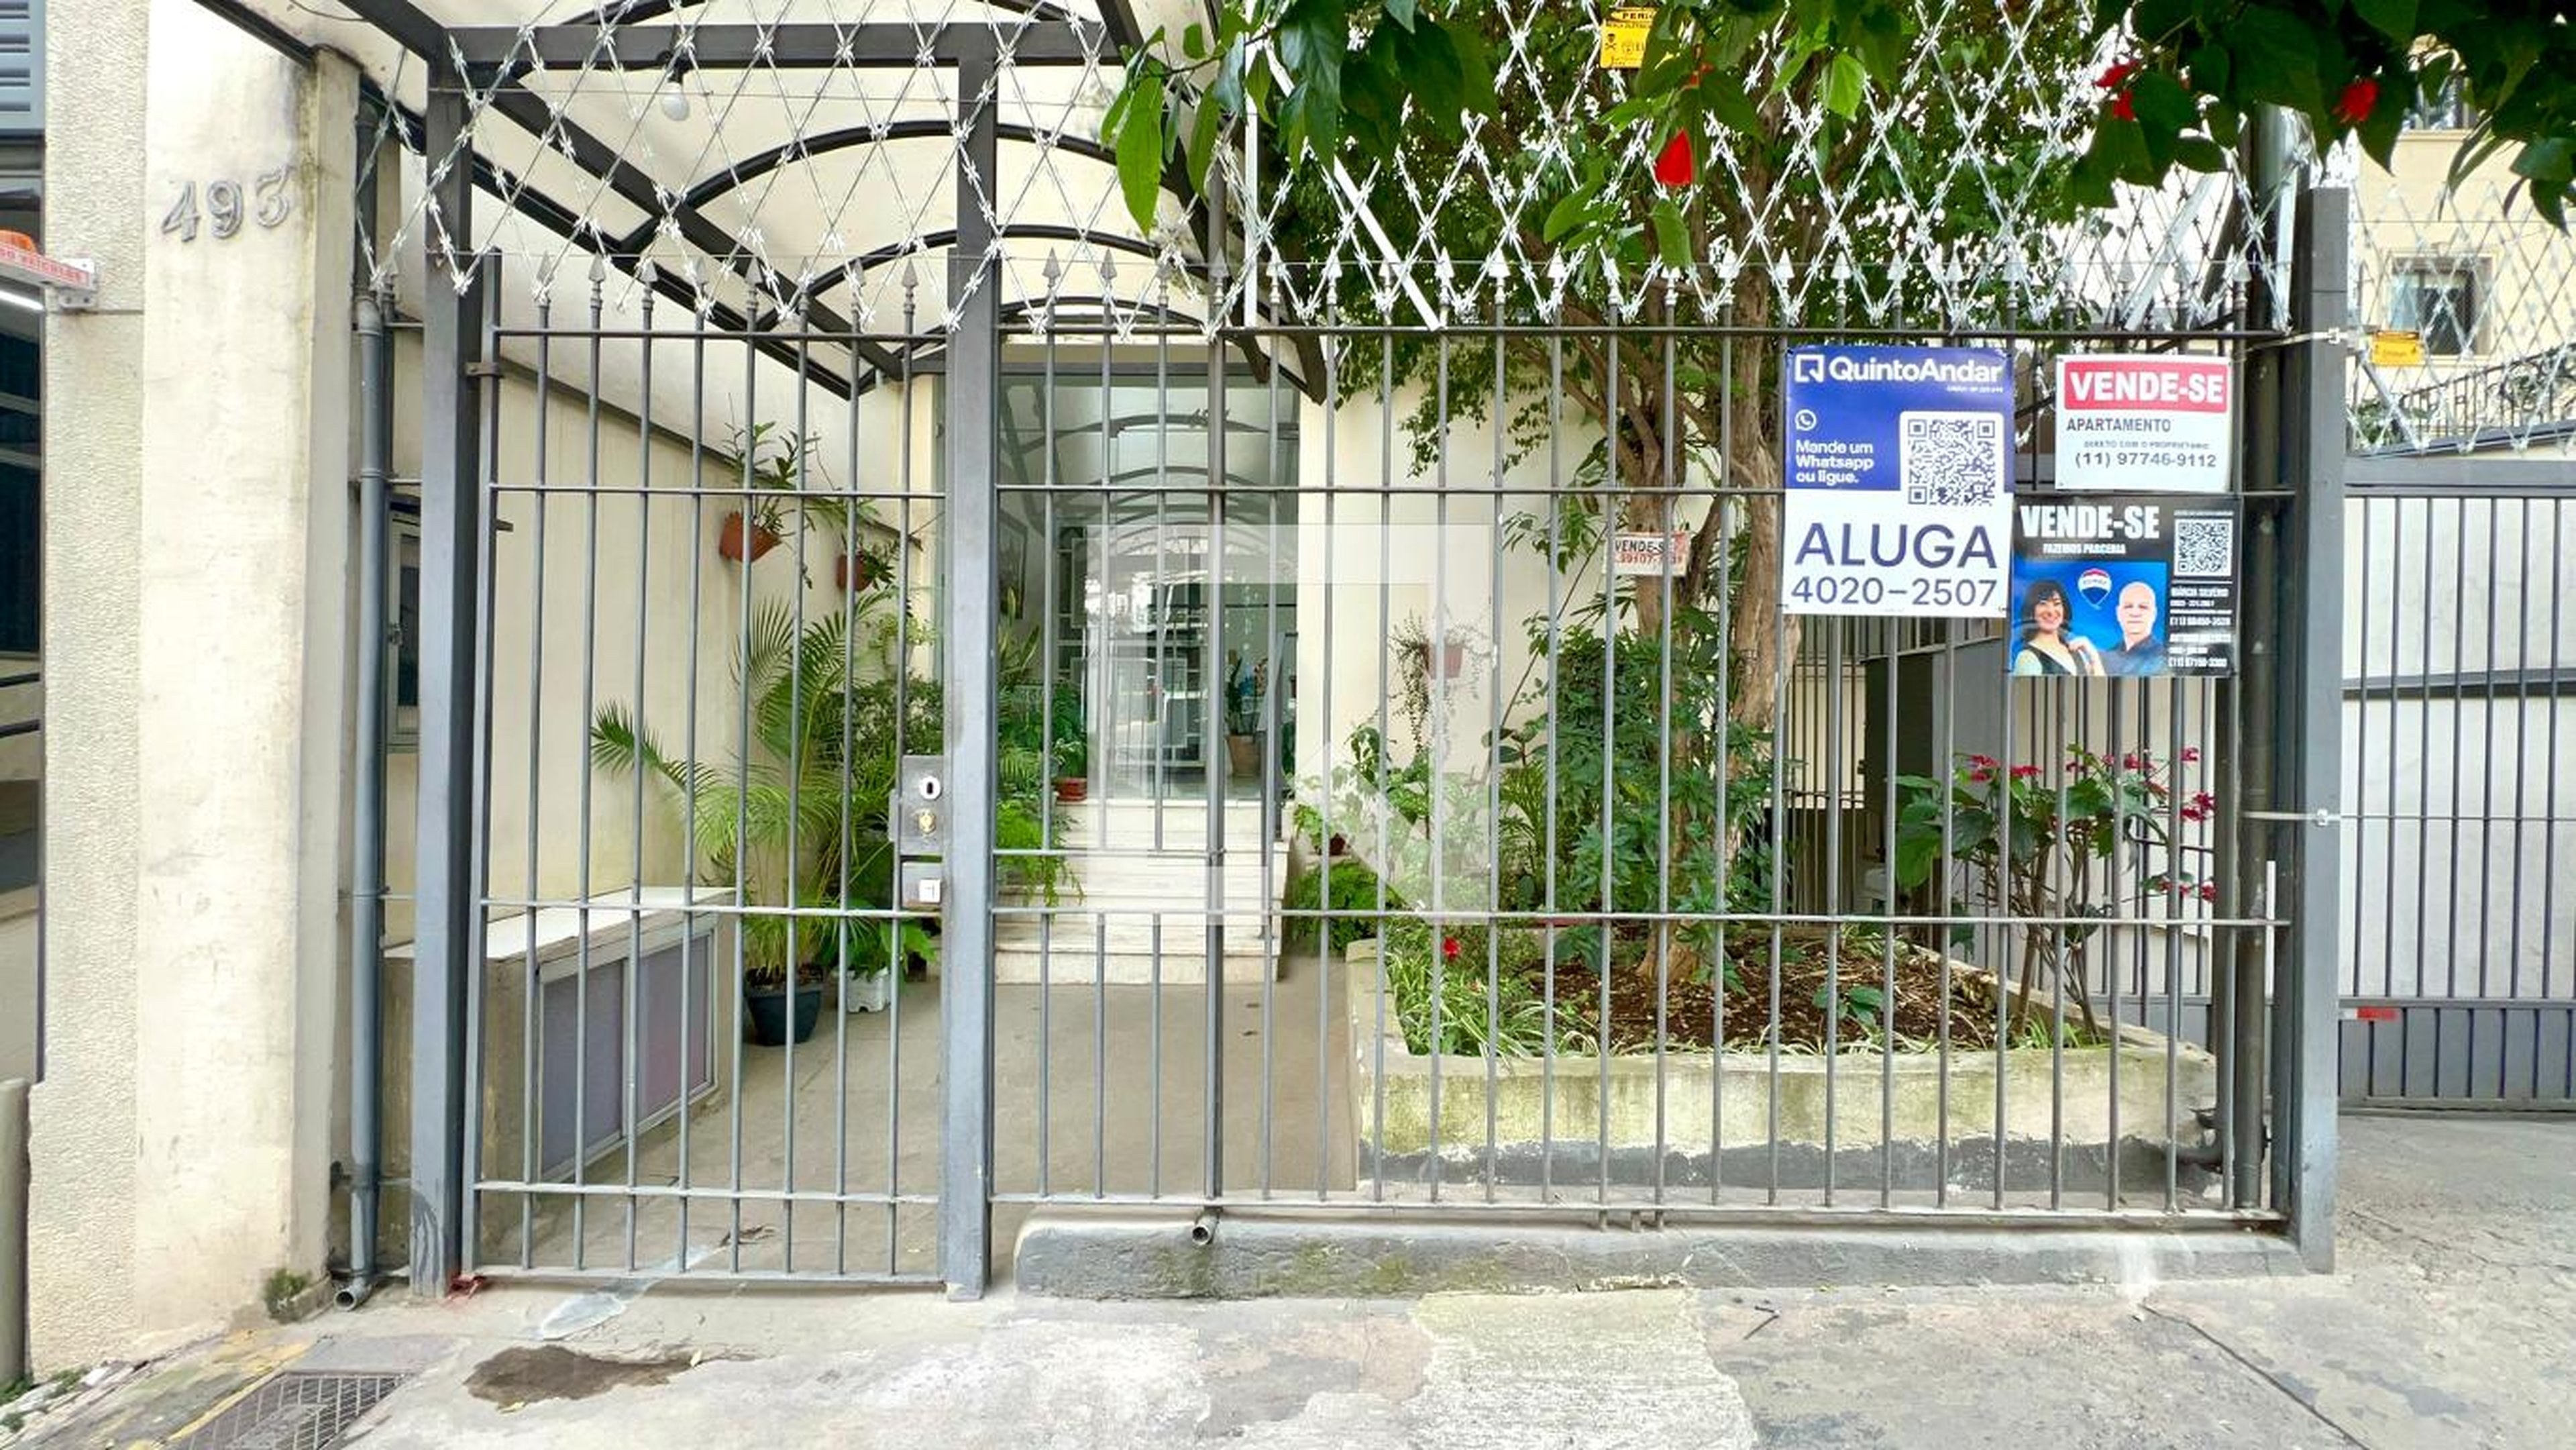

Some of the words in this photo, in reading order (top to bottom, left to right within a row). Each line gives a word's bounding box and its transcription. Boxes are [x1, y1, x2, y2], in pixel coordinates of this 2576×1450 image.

[160, 164, 290, 243] 493
[1829, 356, 2002, 382] QuintoAndar
[2070, 371, 2224, 404] VENDE-SE
[2066, 418, 2171, 432] APARTAMENTO
[1796, 439, 1847, 454] Mande
[1850, 444, 1873, 454] um
[1796, 455, 1874, 471] Whatsapp
[2076, 452, 2110, 468] (11)
[2117, 452, 2217, 468] 97746-9112
[1796, 472, 1815, 483] ou
[1819, 470, 1859, 486] ligue.
[2020, 505, 2160, 539] VENDE-SE
[1794, 521, 1998, 569] ALUGA
[1791, 575, 1997, 607] 4020-2507
